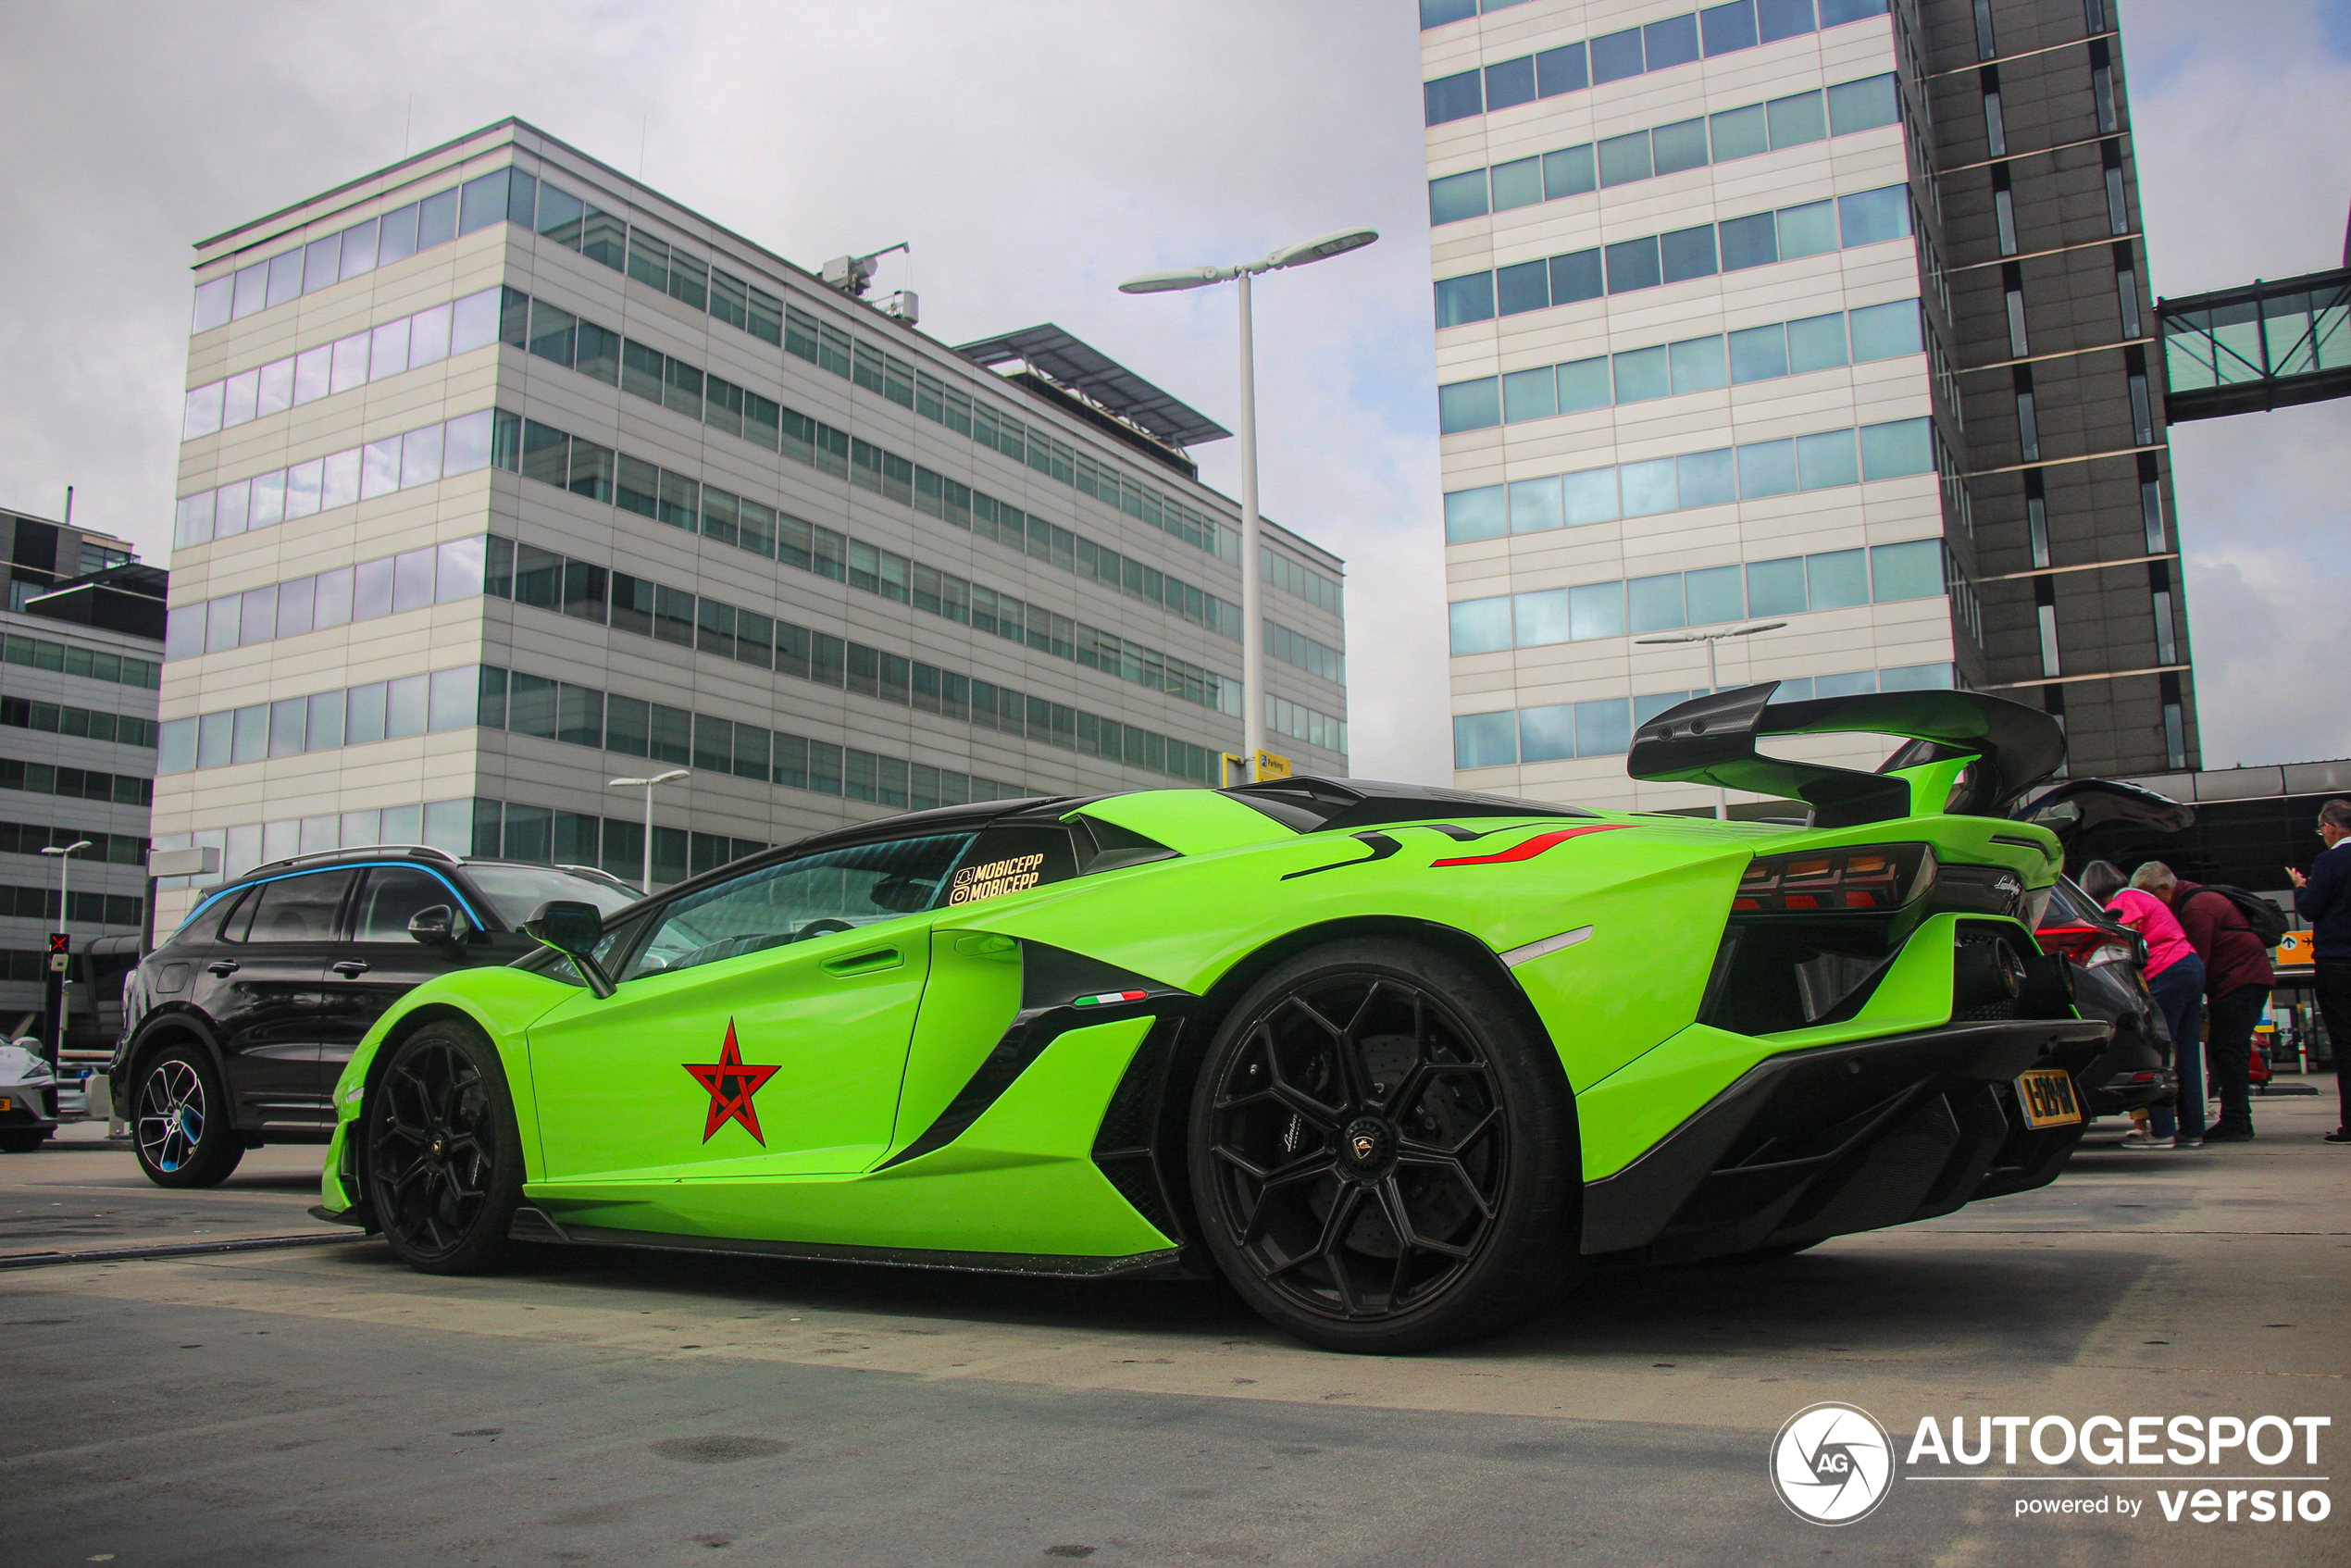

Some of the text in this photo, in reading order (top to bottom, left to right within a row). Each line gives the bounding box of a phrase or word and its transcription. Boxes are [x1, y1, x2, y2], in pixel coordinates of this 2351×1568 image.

[1268, 758, 1284, 772] Parking
[974, 852, 1044, 883] MOBICEPP
[969, 872, 1039, 902] MOBICEPP
